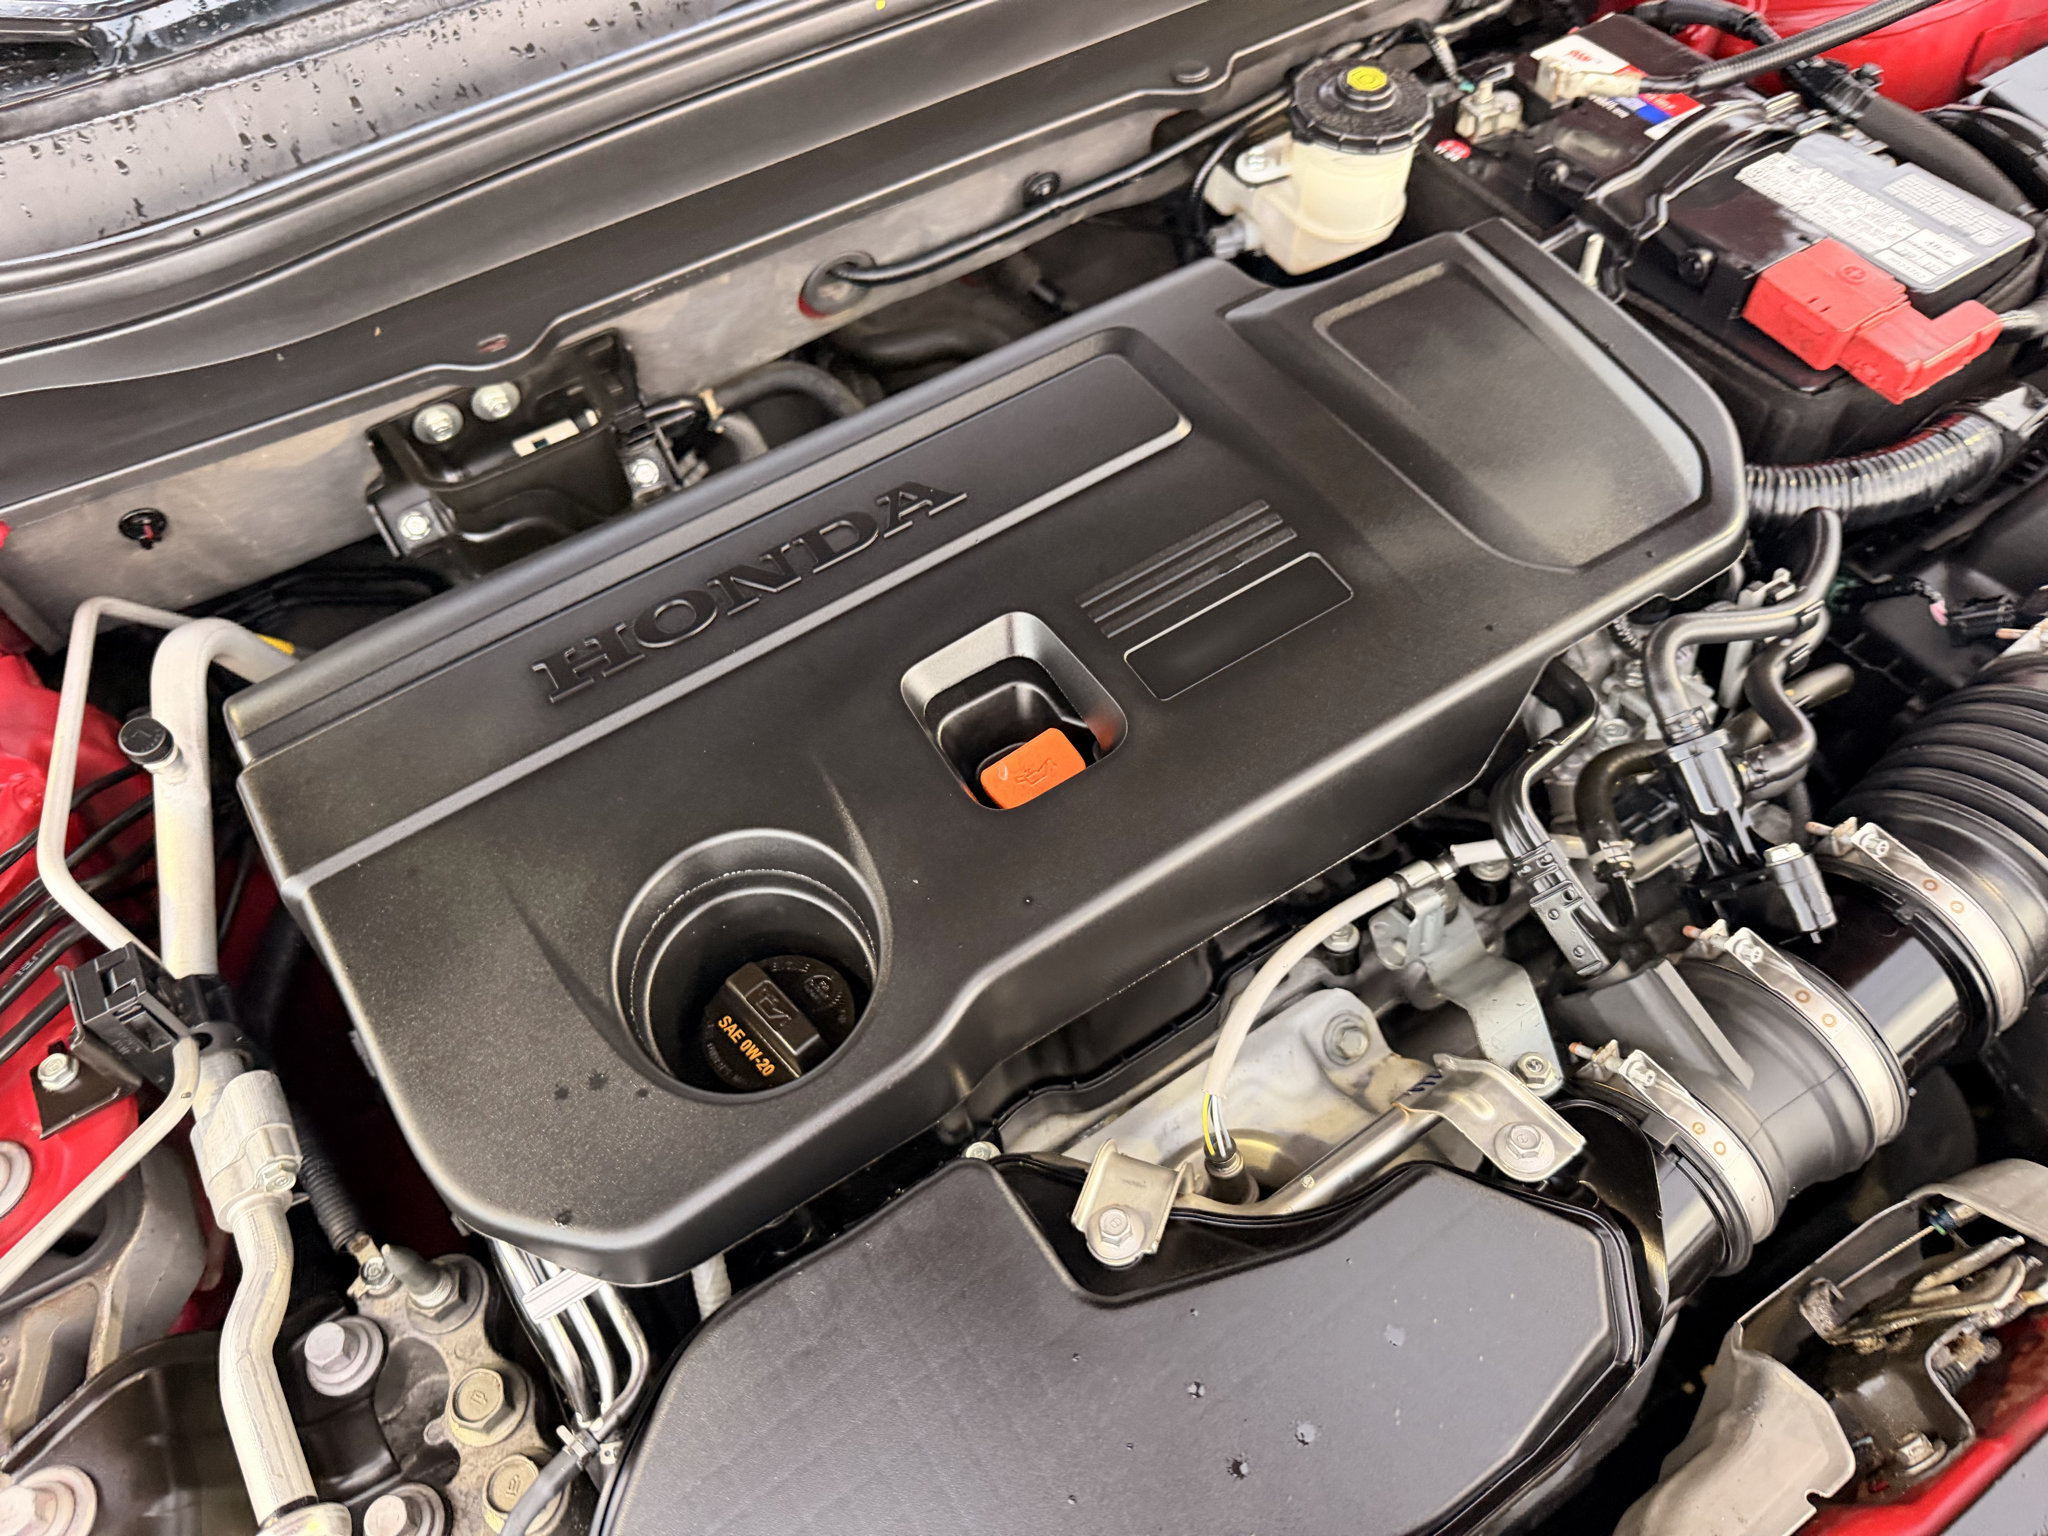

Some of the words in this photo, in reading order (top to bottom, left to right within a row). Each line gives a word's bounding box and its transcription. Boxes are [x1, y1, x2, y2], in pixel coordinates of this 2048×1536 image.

[532, 481, 967, 702] HONDA
[718, 1015, 746, 1044] SAE
[740, 1039, 776, 1077] 0W-20
